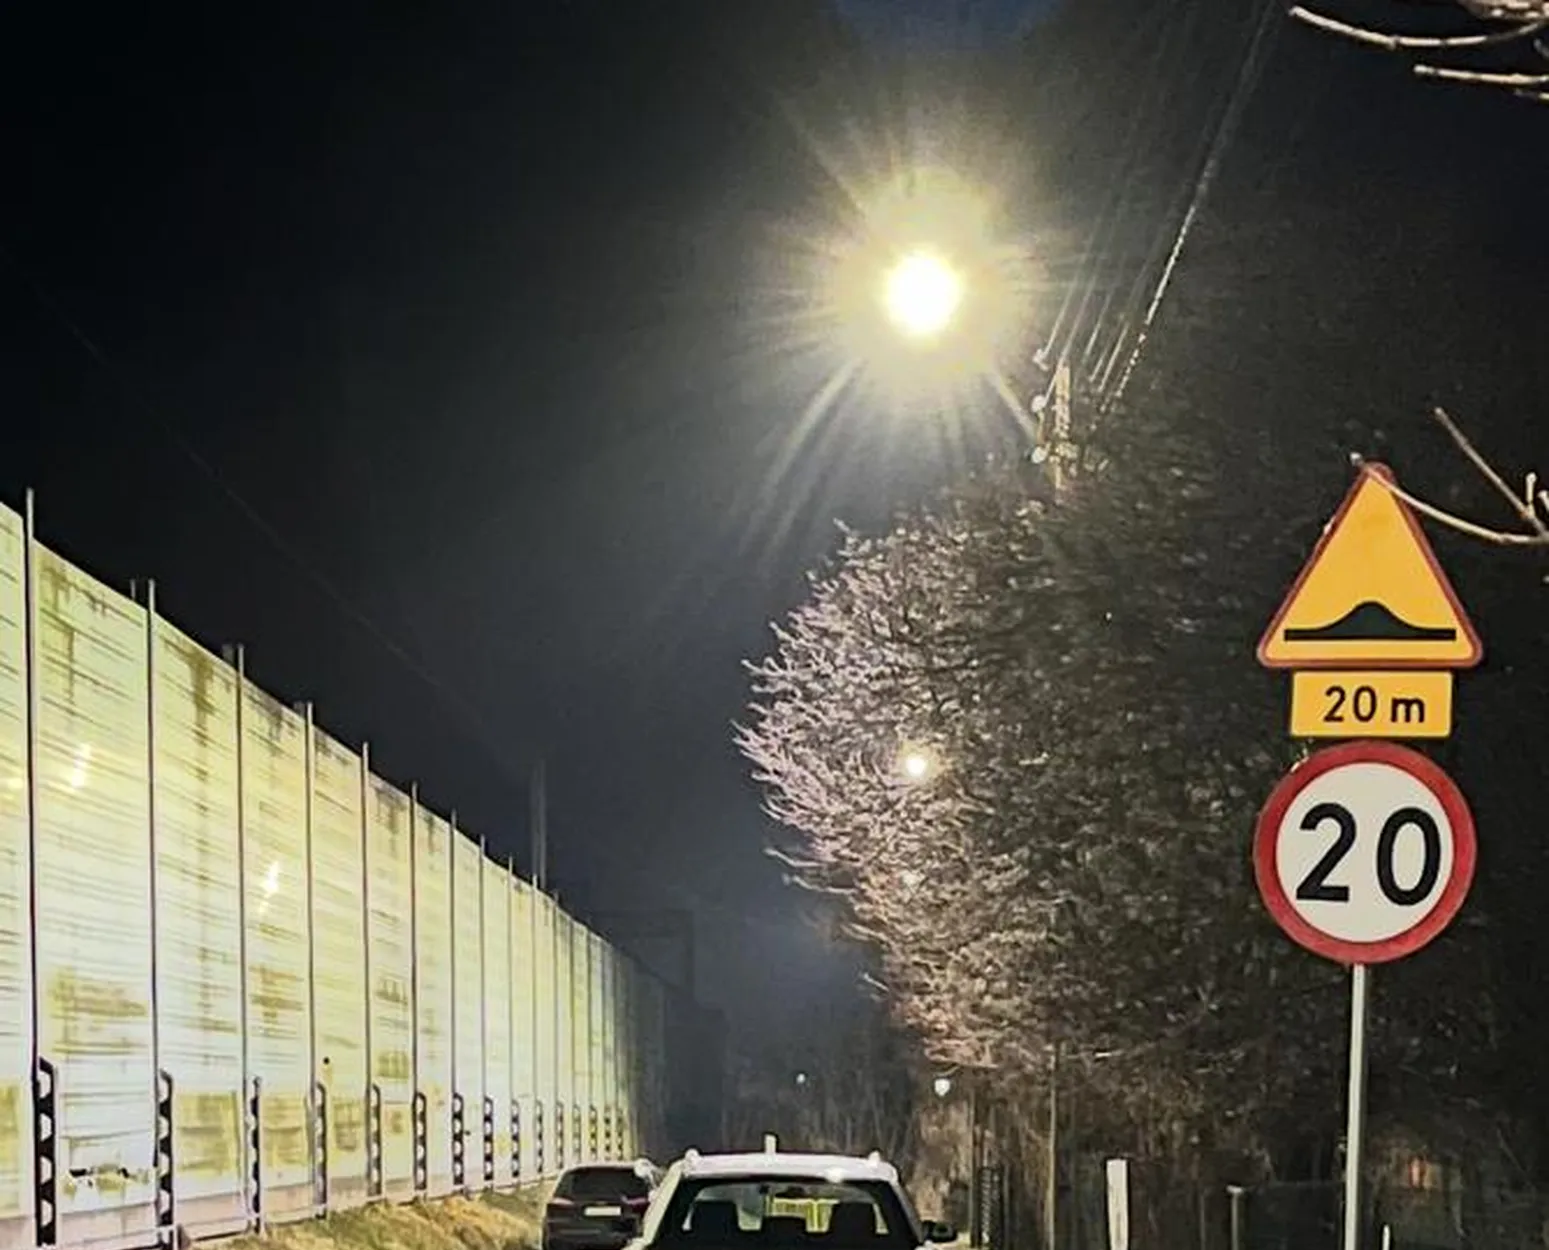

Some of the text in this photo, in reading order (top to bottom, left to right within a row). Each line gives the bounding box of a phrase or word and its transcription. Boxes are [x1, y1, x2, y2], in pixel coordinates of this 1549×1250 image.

[1323, 686, 1425, 722] 20 m
[1296, 802, 1441, 906] 20
